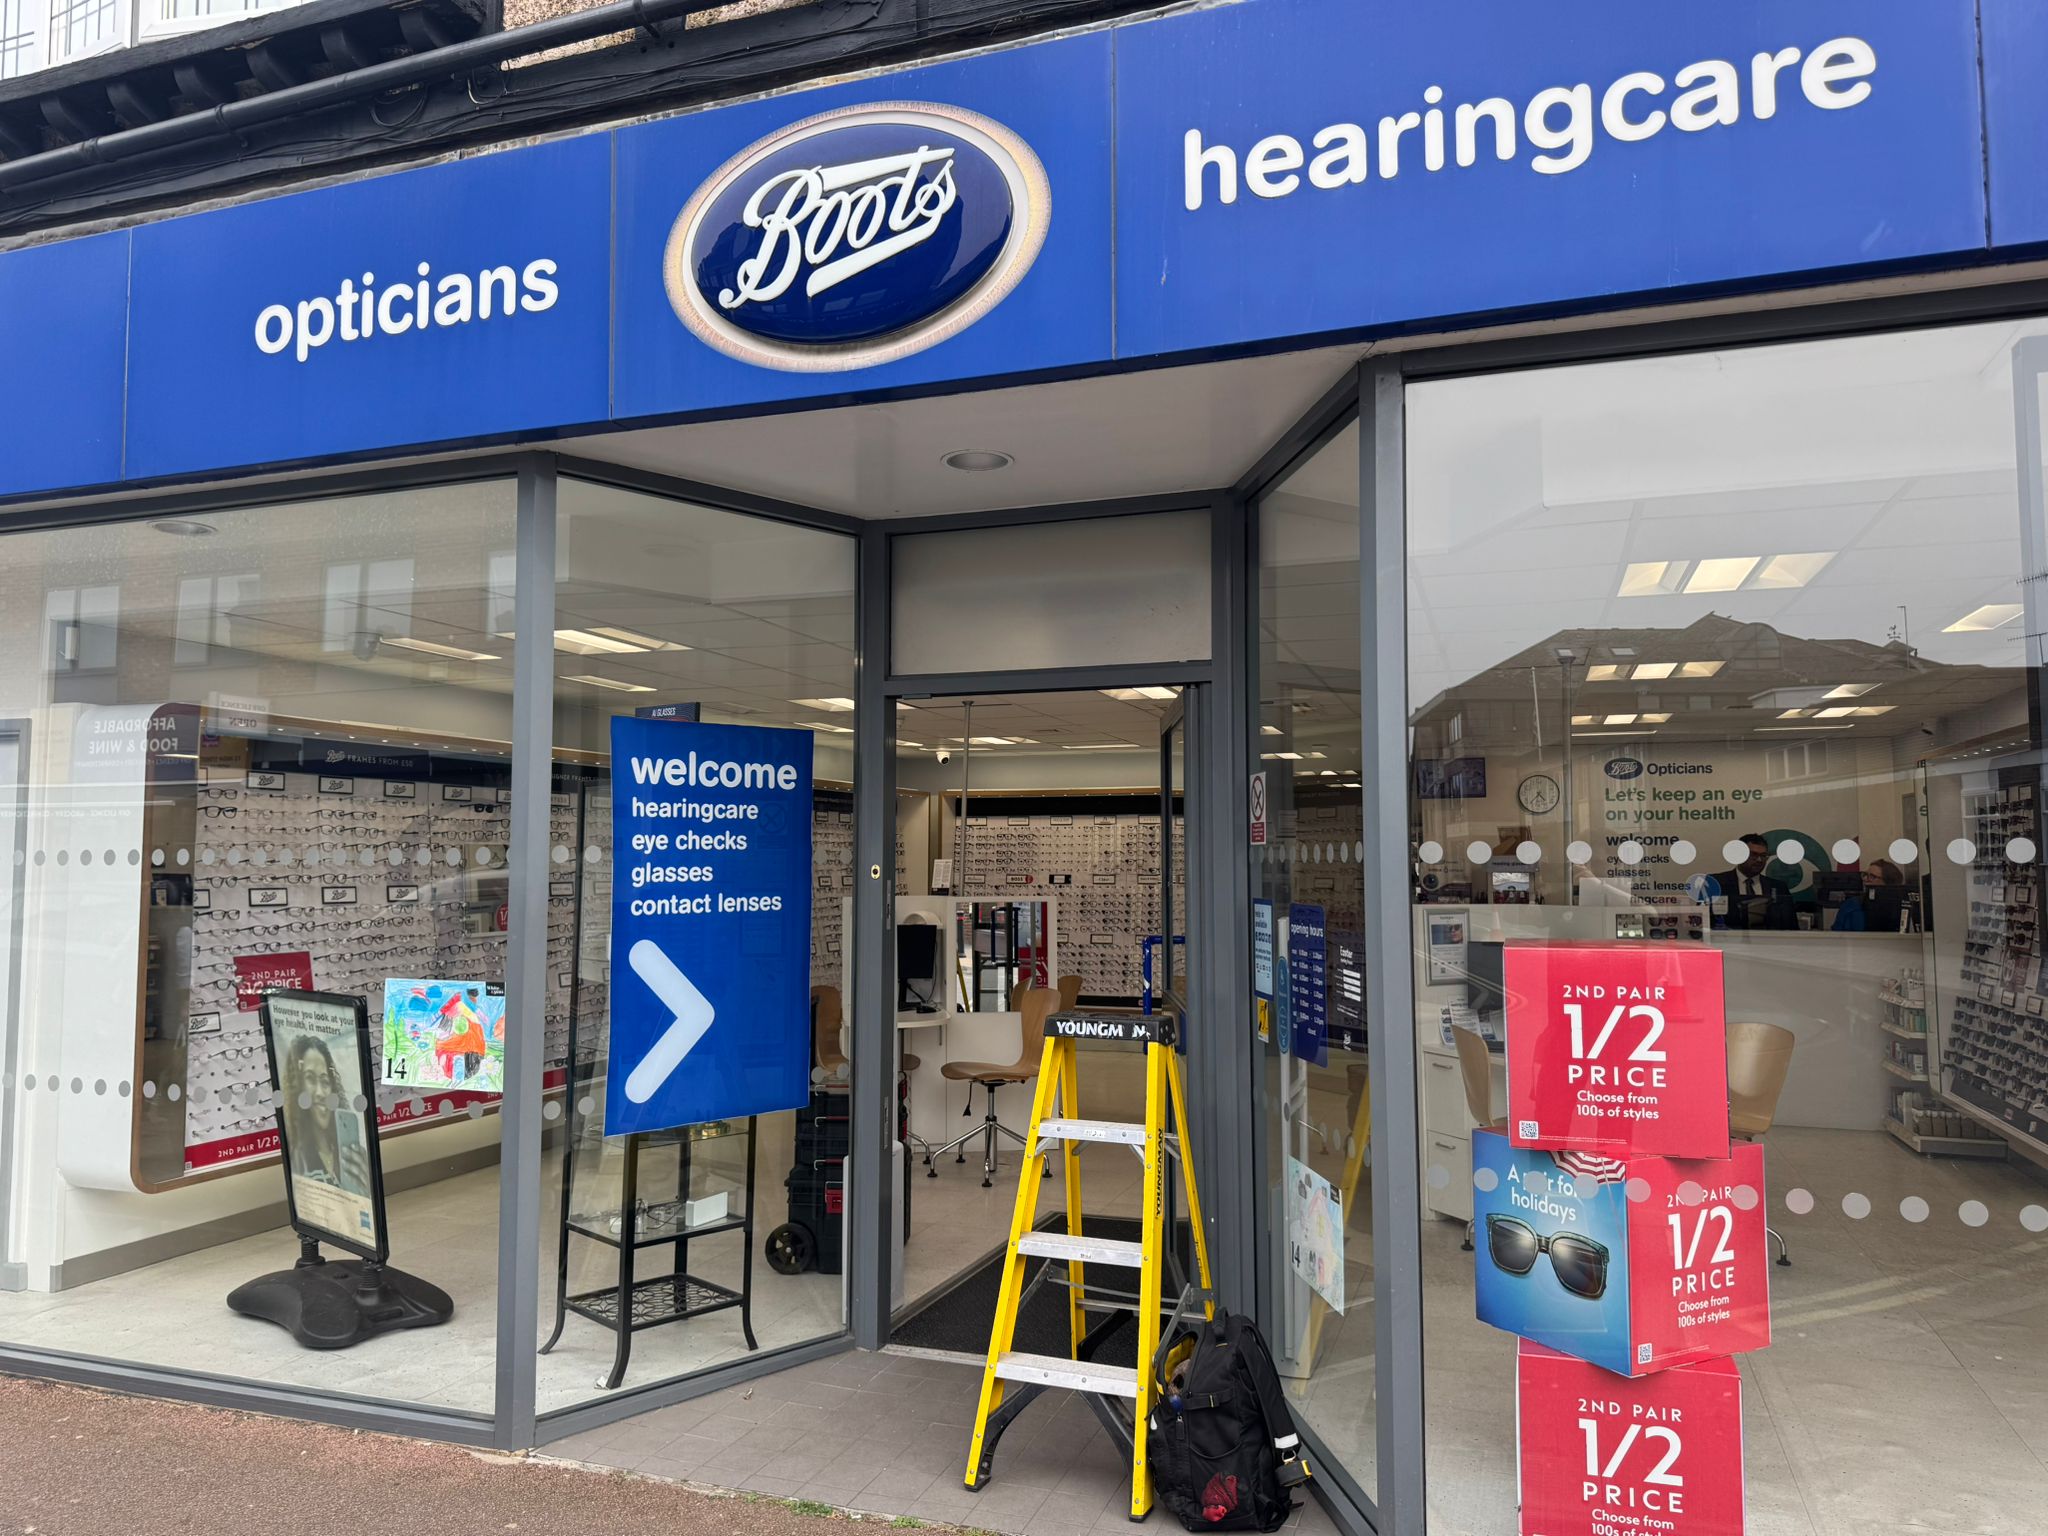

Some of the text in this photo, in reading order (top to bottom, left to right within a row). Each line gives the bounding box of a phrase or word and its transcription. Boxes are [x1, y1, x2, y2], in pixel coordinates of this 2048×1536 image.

[1184, 35, 1877, 211] hearingcare
[718, 145, 957, 310] Boots
[254, 257, 559, 362] opticians
[348, 754, 376, 764] FRAMES
[630, 750, 798, 790] welcome
[1647, 762, 1713, 776] Opticians
[1605, 788, 1762, 803] Let's keep an eye
[632, 797, 759, 822] hearingcare
[1606, 806, 1736, 823] on your health
[632, 829, 748, 854] eye checks
[1606, 856, 1622, 865] ey
[631, 862, 714, 888] glasses
[1606, 868, 1651, 878] glasses
[1654, 881, 1691, 890] lenses
[630, 893, 782, 916] contact lenses
[1290, 922, 1324, 938] opening hours
[251, 969, 296, 980] 2ND PAIR
[1563, 985, 1665, 1000] 2ND PAIR
[273, 1005, 300, 1018] However
[301, 1010, 313, 1020] you
[314, 1011, 328, 1021] look
[339, 1016, 354, 1026] your
[1056, 1020, 1147, 1038] YOUNGMN
[1564, 1004, 1666, 1062] 1/2
[386, 1058, 408, 1079] 14
[1568, 1065, 1666, 1088] PRICE
[1577, 1090, 1658, 1104] Choose from
[1577, 1105, 1659, 1121] 100s of styles
[218, 1146, 234, 1158] 2ND
[237, 1144, 254, 1154] PAIR
[256, 1138, 271, 1150] 1/2
[1156, 1128, 1164, 1217] YOUNGMAN
[1508, 1164, 1520, 1183] A
[1558, 1175, 1577, 1198] fo
[1512, 1186, 1576, 1224] holidays
[1667, 1186, 1732, 1208] 2N PAIR
[1668, 1205, 1734, 1270] 1/2
[1291, 1240, 1300, 1268] 14
[1672, 1266, 1735, 1296] PRICE
[1678, 1296, 1730, 1314] Choose from
[1678, 1309, 1730, 1328] 100s of styles
[1578, 1398, 1682, 1422] 2ND PAIR
[1578, 1417, 1684, 1486] 1/2
[1583, 1481, 1684, 1514] PRICE
[1592, 1508, 1674, 1530] Choose from
[1592, 1522, 1620, 1536] 100s
